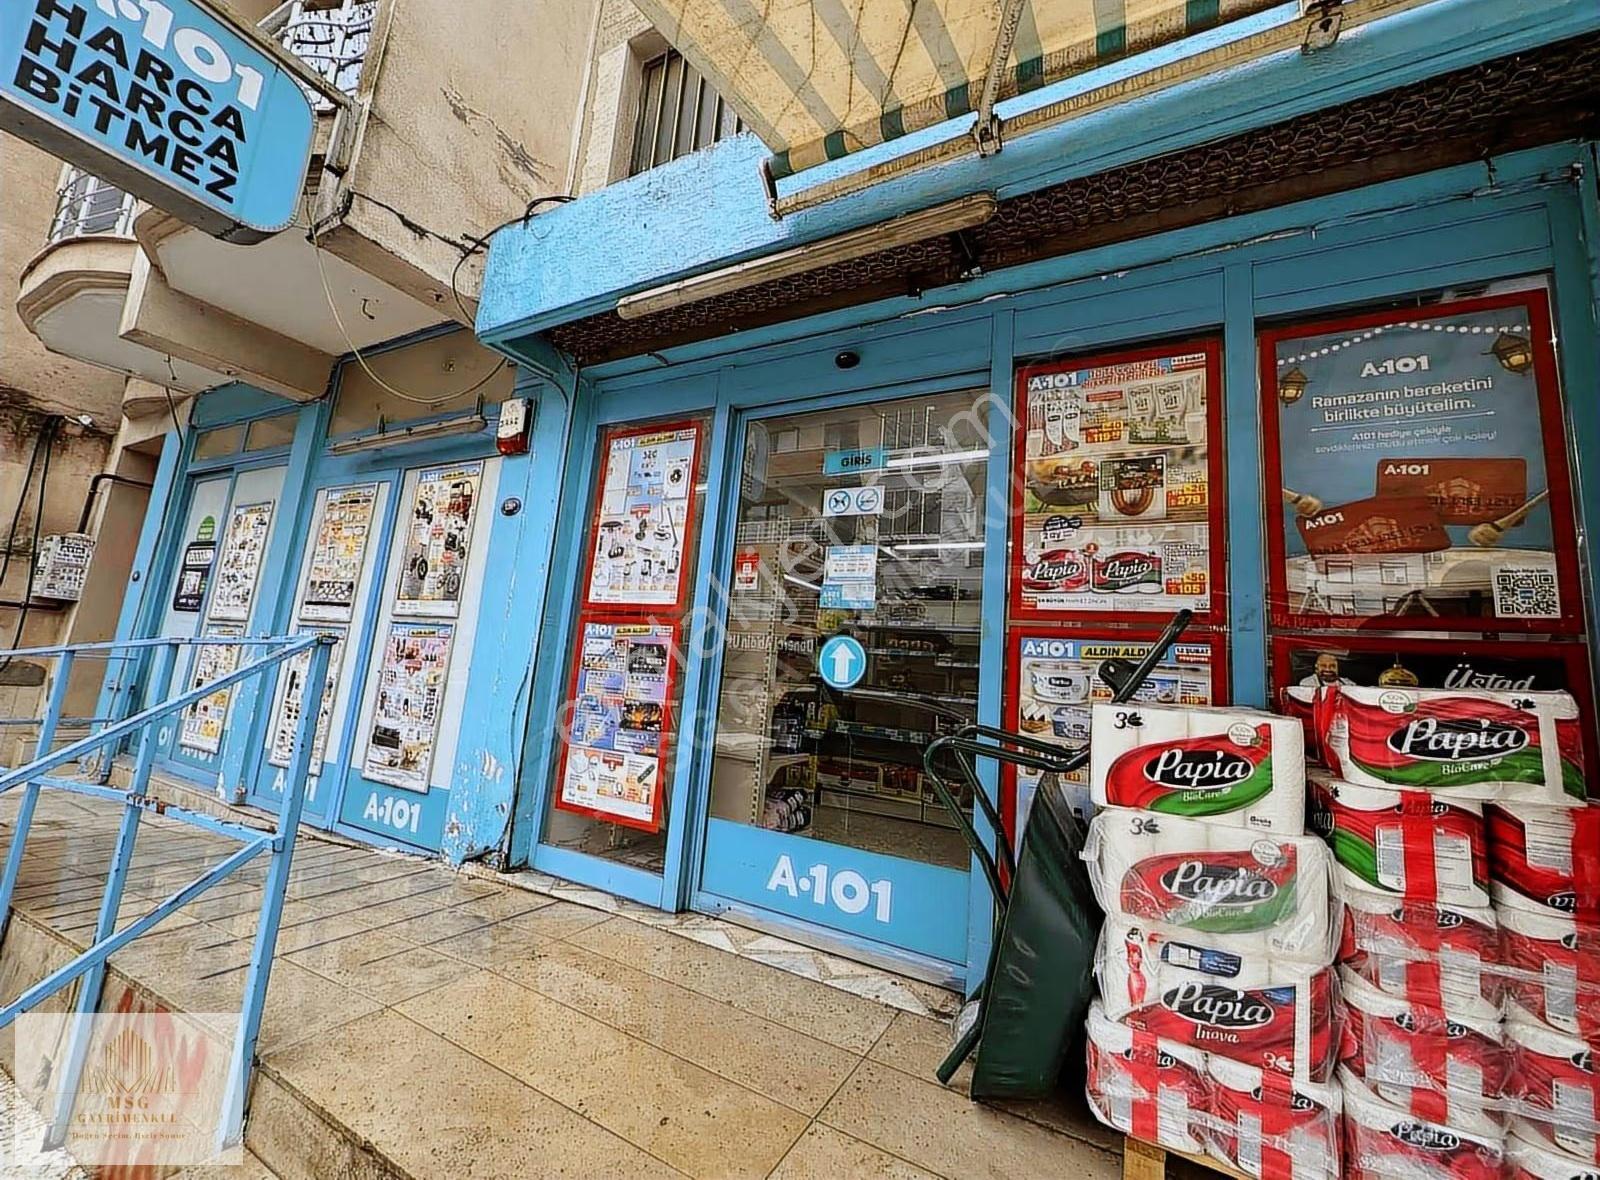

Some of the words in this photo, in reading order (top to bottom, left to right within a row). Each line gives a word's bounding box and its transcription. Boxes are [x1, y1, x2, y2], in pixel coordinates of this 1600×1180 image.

[36, 0, 247, 144] HARCA
[24, 20, 240, 174] HARCA
[1312, 390, 1400, 408] Ramazanın
[1404, 377, 1493, 398] bereketini
[1324, 404, 1380, 423] birlikte
[1384, 398, 1476, 418] büyütelim.
[1034, 562, 1078, 580] Papia
[1105, 560, 1149, 580] Papia
[1085, 647, 1121, 657] ALDIN
[1114, 712, 1127, 729] 3
[1400, 718, 1522, 759] Papia
[1153, 749, 1248, 787] Papia
[1130, 817, 1143, 835] 3
[1170, 861, 1270, 907] Papia
[1171, 980, 1269, 1024] Papia
[1195, 1024, 1240, 1043] Inova
